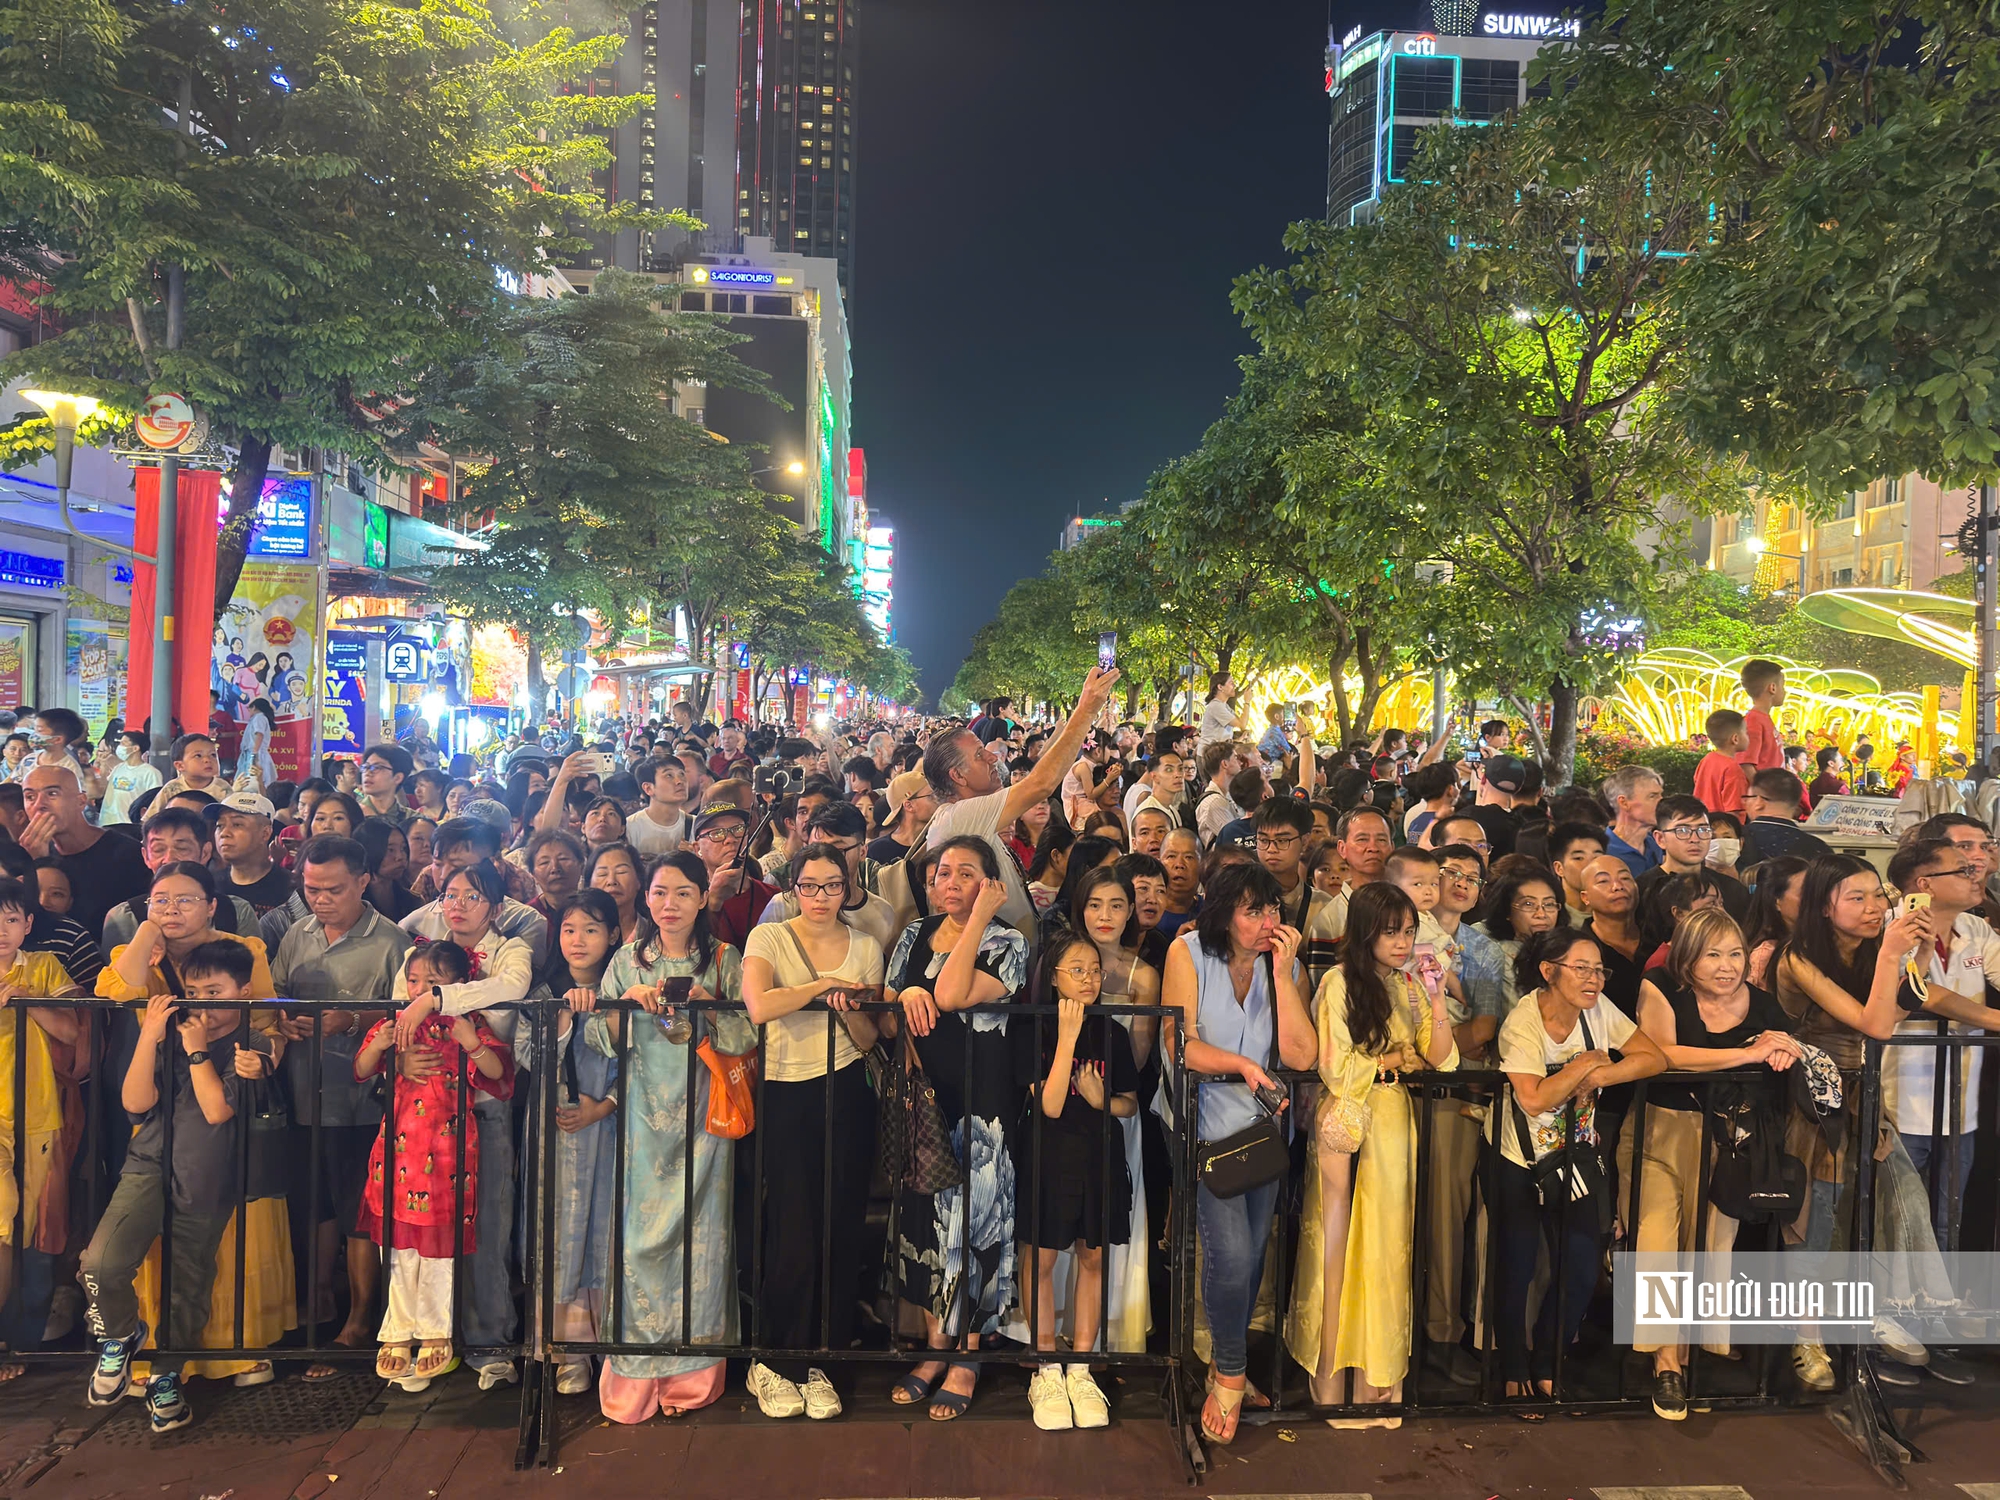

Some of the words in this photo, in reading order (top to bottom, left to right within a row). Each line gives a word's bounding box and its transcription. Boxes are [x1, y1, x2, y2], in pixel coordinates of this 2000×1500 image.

[1403, 39, 1436, 56] citi
[711, 271, 773, 283] SAIGONTOURIST
[278, 509, 305, 519] Bank
[1860, 806, 1869, 815] TY
